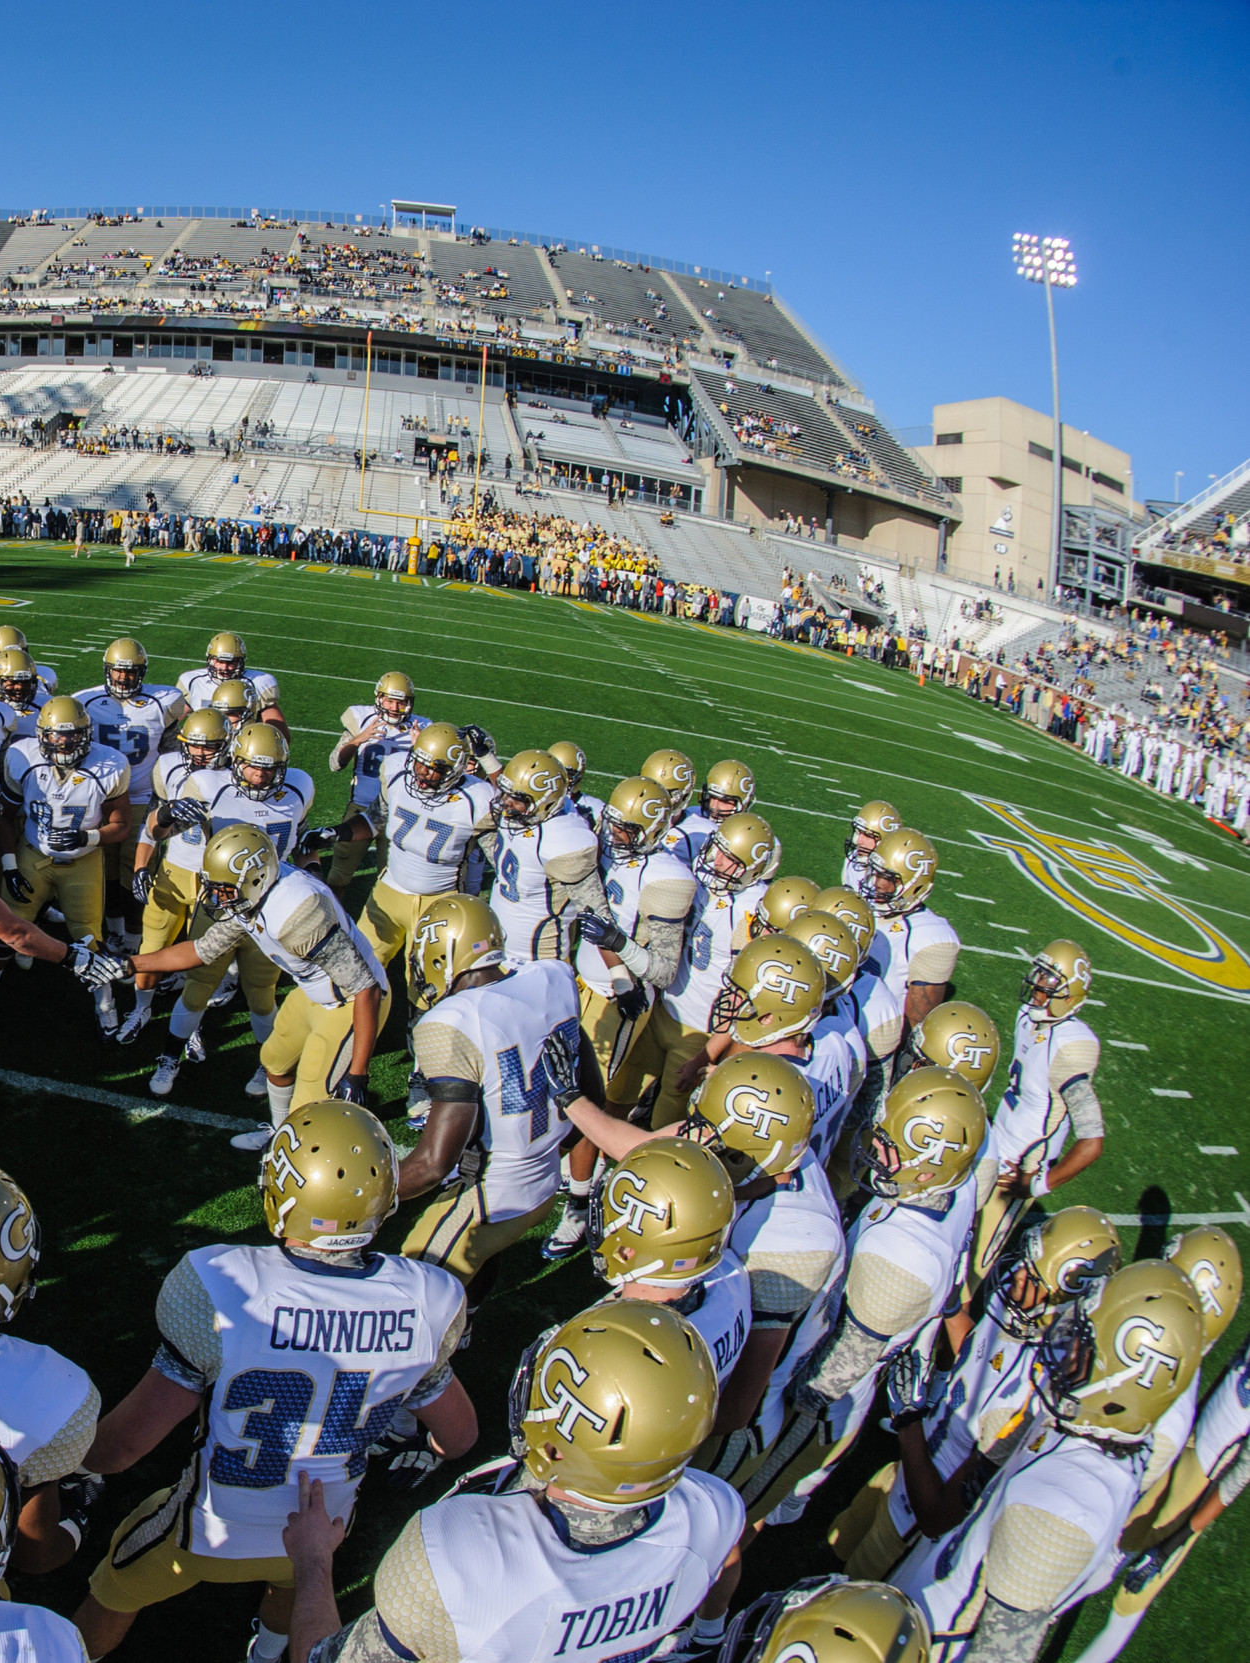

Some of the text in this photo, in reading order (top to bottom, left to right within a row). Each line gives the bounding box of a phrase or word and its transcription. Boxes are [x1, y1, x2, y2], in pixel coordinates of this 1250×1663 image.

[512, 347, 537, 359] 24:36
[556, 354, 562, 364] 0
[609, 364, 615, 373] 0
[256, 755, 269, 763] ACC
[51, 793, 67, 801] TECH
[528, 770, 563, 793] GT
[254, 810, 269, 818] TECH
[608, 805, 620, 817] ACC
[641, 798, 671, 822] GT
[392, 806, 455, 864] 77
[228, 846, 267, 875] GT
[904, 850, 935, 876] GT
[414, 915, 448, 946] GT
[807, 933, 851, 973] GT
[756, 959, 810, 1005] GT
[1072, 957, 1093, 992] GT
[946, 1032, 992, 1070] GT
[724, 1084, 790, 1140] GT
[270, 1123, 307, 1194] GT
[903, 1115, 961, 1167] GT
[607, 1169, 667, 1236] GT
[327, 1235, 367, 1246] JACKETS
[345, 1220, 358, 1231] 34
[1189, 1259, 1224, 1318] GT
[270, 1304, 416, 1353] CONNORS
[1114, 1315, 1180, 1389] GT
[539, 1346, 608, 1444] GT
[208, 1366, 410, 1491] 34
[554, 1580, 675, 1657] TOBIN
